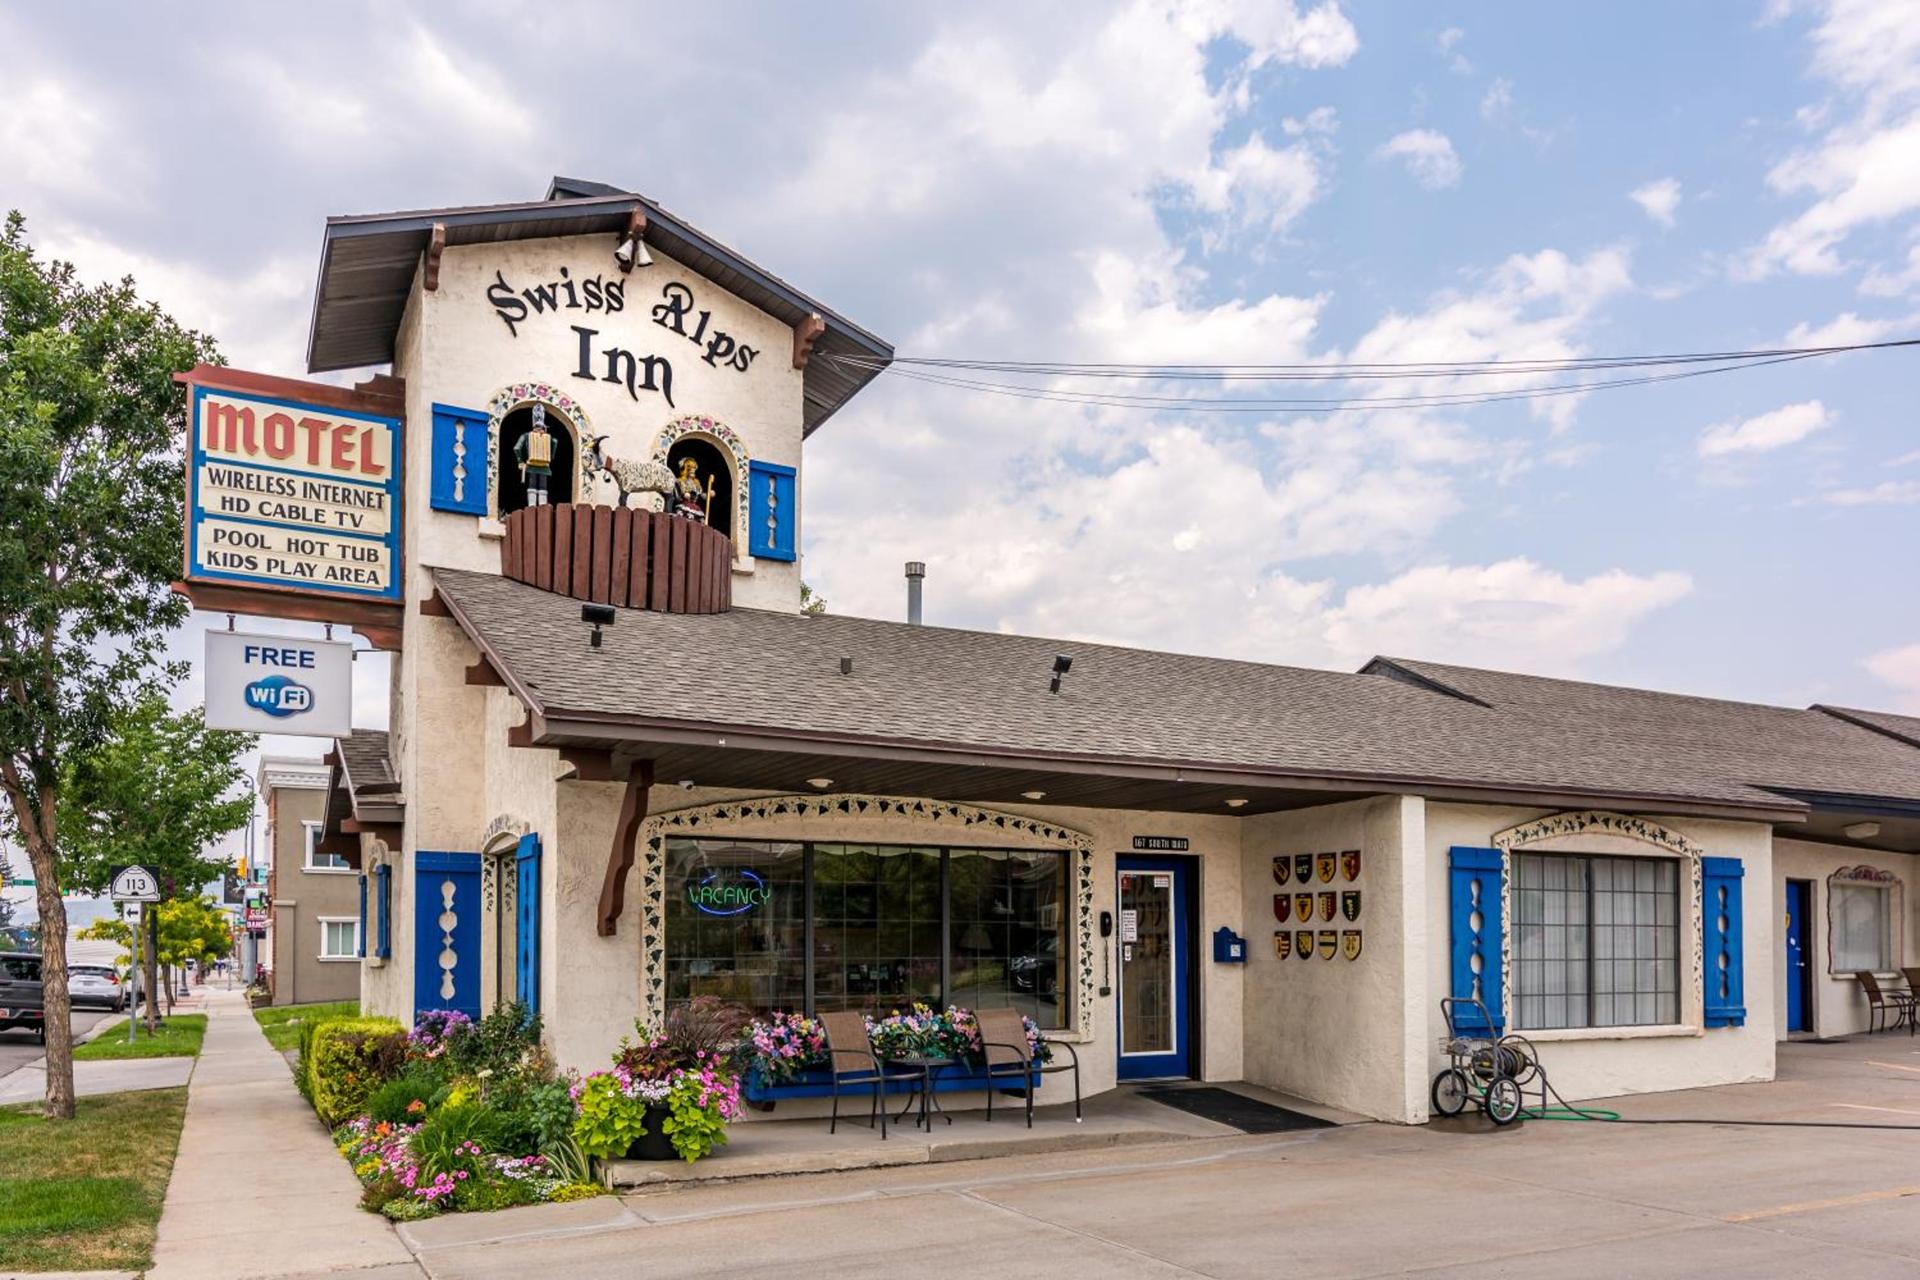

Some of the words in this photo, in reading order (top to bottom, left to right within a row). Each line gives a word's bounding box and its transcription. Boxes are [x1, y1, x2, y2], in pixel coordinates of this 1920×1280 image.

[487, 266, 625, 338] Swiss
[652, 282, 760, 372] Alps
[570, 325, 675, 408] Inn
[206, 401, 385, 475] MOTEL
[208, 467, 296, 496] WIRELESS
[303, 482, 385, 509] INTERNET
[221, 496, 250, 513] HD
[258, 501, 326, 523] CABLE
[335, 511, 364, 528] TV
[213, 528, 272, 549] POOL
[287, 537, 329, 556] HOT
[337, 544, 379, 563] TUB
[207, 550, 258, 570] KIDS
[266, 558, 317, 577] PLAY
[324, 566, 380, 585] AREA
[244, 645, 316, 669] FREE
[127, 879, 146, 891] 113
[688, 886, 771, 905] VACANCY
